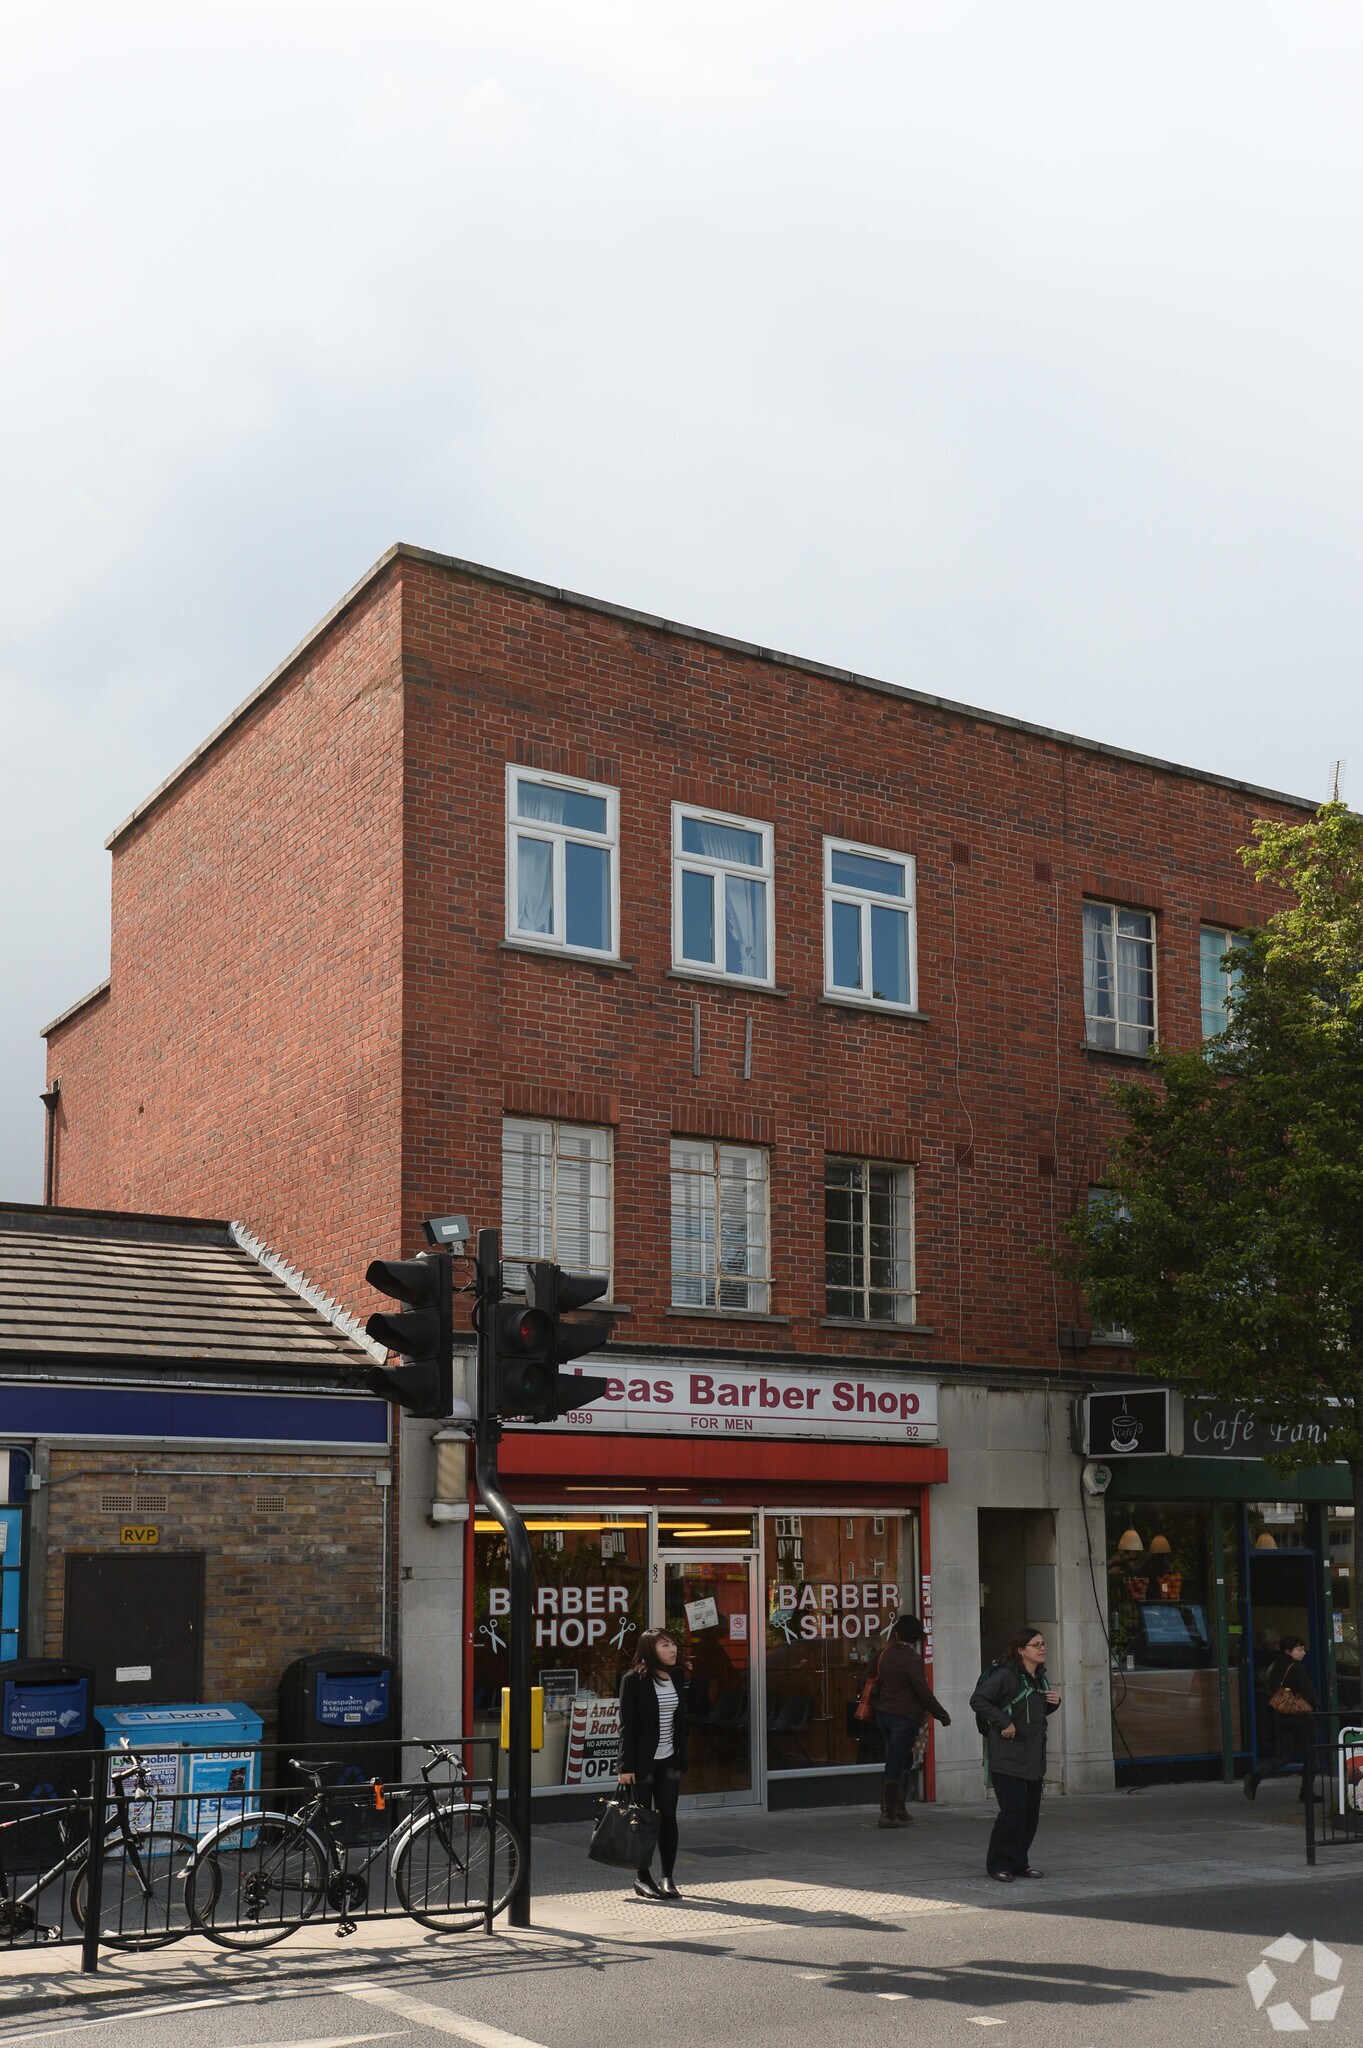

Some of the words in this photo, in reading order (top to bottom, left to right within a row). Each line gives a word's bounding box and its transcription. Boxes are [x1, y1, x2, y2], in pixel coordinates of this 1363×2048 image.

[689, 1374, 821, 1410] Barber
[831, 1382, 920, 1420] Shop
[566, 1412, 593, 1425] 1959
[690, 1417, 718, 1430] FOR
[724, 1419, 753, 1431] MEN
[906, 1426, 919, 1437] 82
[1192, 1408, 1255, 1452] Café
[124, 1529, 156, 1541] RVP
[653, 1563, 659, 1584] 82
[489, 1586, 629, 1616] BRBER
[778, 1583, 899, 1610] BARBER
[535, 1618, 607, 1647] HOP
[800, 1614, 881, 1640] SHOP
[12, 1710, 57, 1718] Newspapers
[329, 1704, 364, 1712] Magazines
[589, 1702, 620, 1718] Andr
[18, 1717, 58, 1725] Magazines
[145, 1711, 221, 1720] Lebara
[205, 1752, 252, 1760] Lebara
[594, 1748, 619, 1756] NECESSA
[112, 1755, 177, 1767] Lymobile
[585, 1759, 618, 1778] OPE
[198, 1799, 219, 1813] £5
